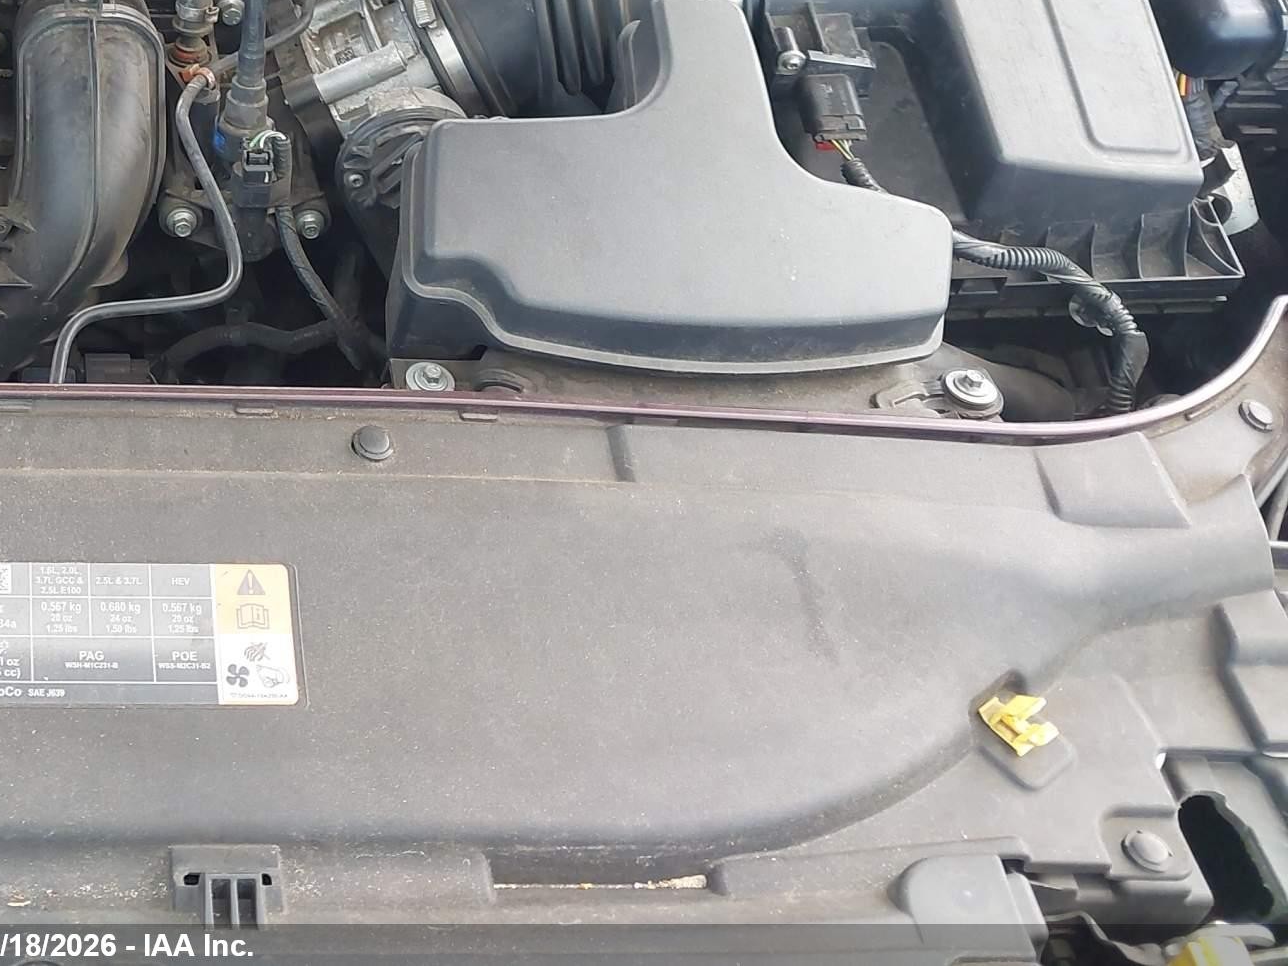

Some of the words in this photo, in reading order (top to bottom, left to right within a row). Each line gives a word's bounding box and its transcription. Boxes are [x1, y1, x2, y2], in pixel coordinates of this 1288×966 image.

[55, 576, 76, 585] GCC
[171, 577, 191, 586] HEV
[60, 585, 82, 595] E100
[40, 601, 66, 613] 0.567
[69, 601, 82, 614] kg
[100, 601, 126, 612] 0.680
[128, 601, 141, 614] kg
[162, 602, 187, 613] 0.567
[189, 602, 202, 615] kg
[62, 615, 73, 623] oz
[183, 616, 194, 624] oz
[45, 624, 63, 634] 1.25
[64, 624, 78, 634] lbs
[105, 624, 123, 634] 1.50
[124, 624, 138, 634] lbs
[78, 650, 105, 662] PAG
[171, 650, 198, 662] POE
[6, 658, 20, 667] oz
[4, 668, 21, 679] cc)
[28, 688, 45, 697] SAE
[46, 688, 65, 697] J639
